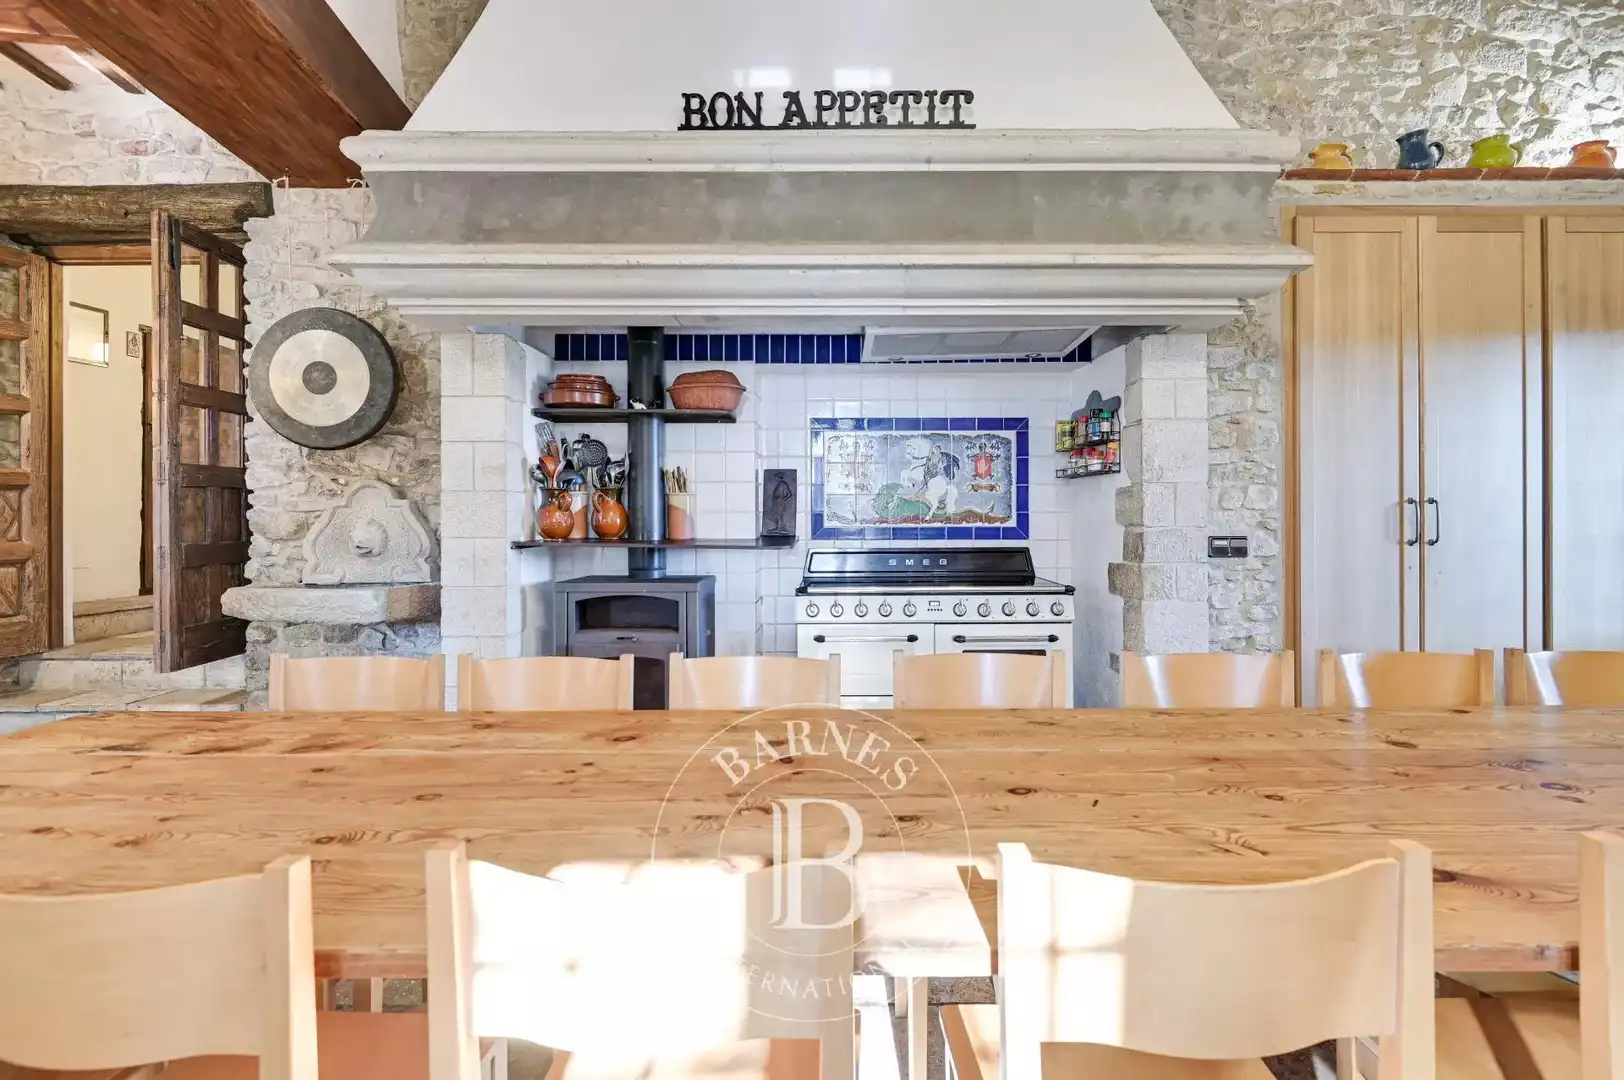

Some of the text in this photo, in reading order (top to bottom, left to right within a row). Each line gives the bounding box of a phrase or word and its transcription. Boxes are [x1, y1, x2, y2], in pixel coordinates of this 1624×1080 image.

[679, 89, 976, 128] BON APPETIT
[888, 558, 948, 566] SMEG
